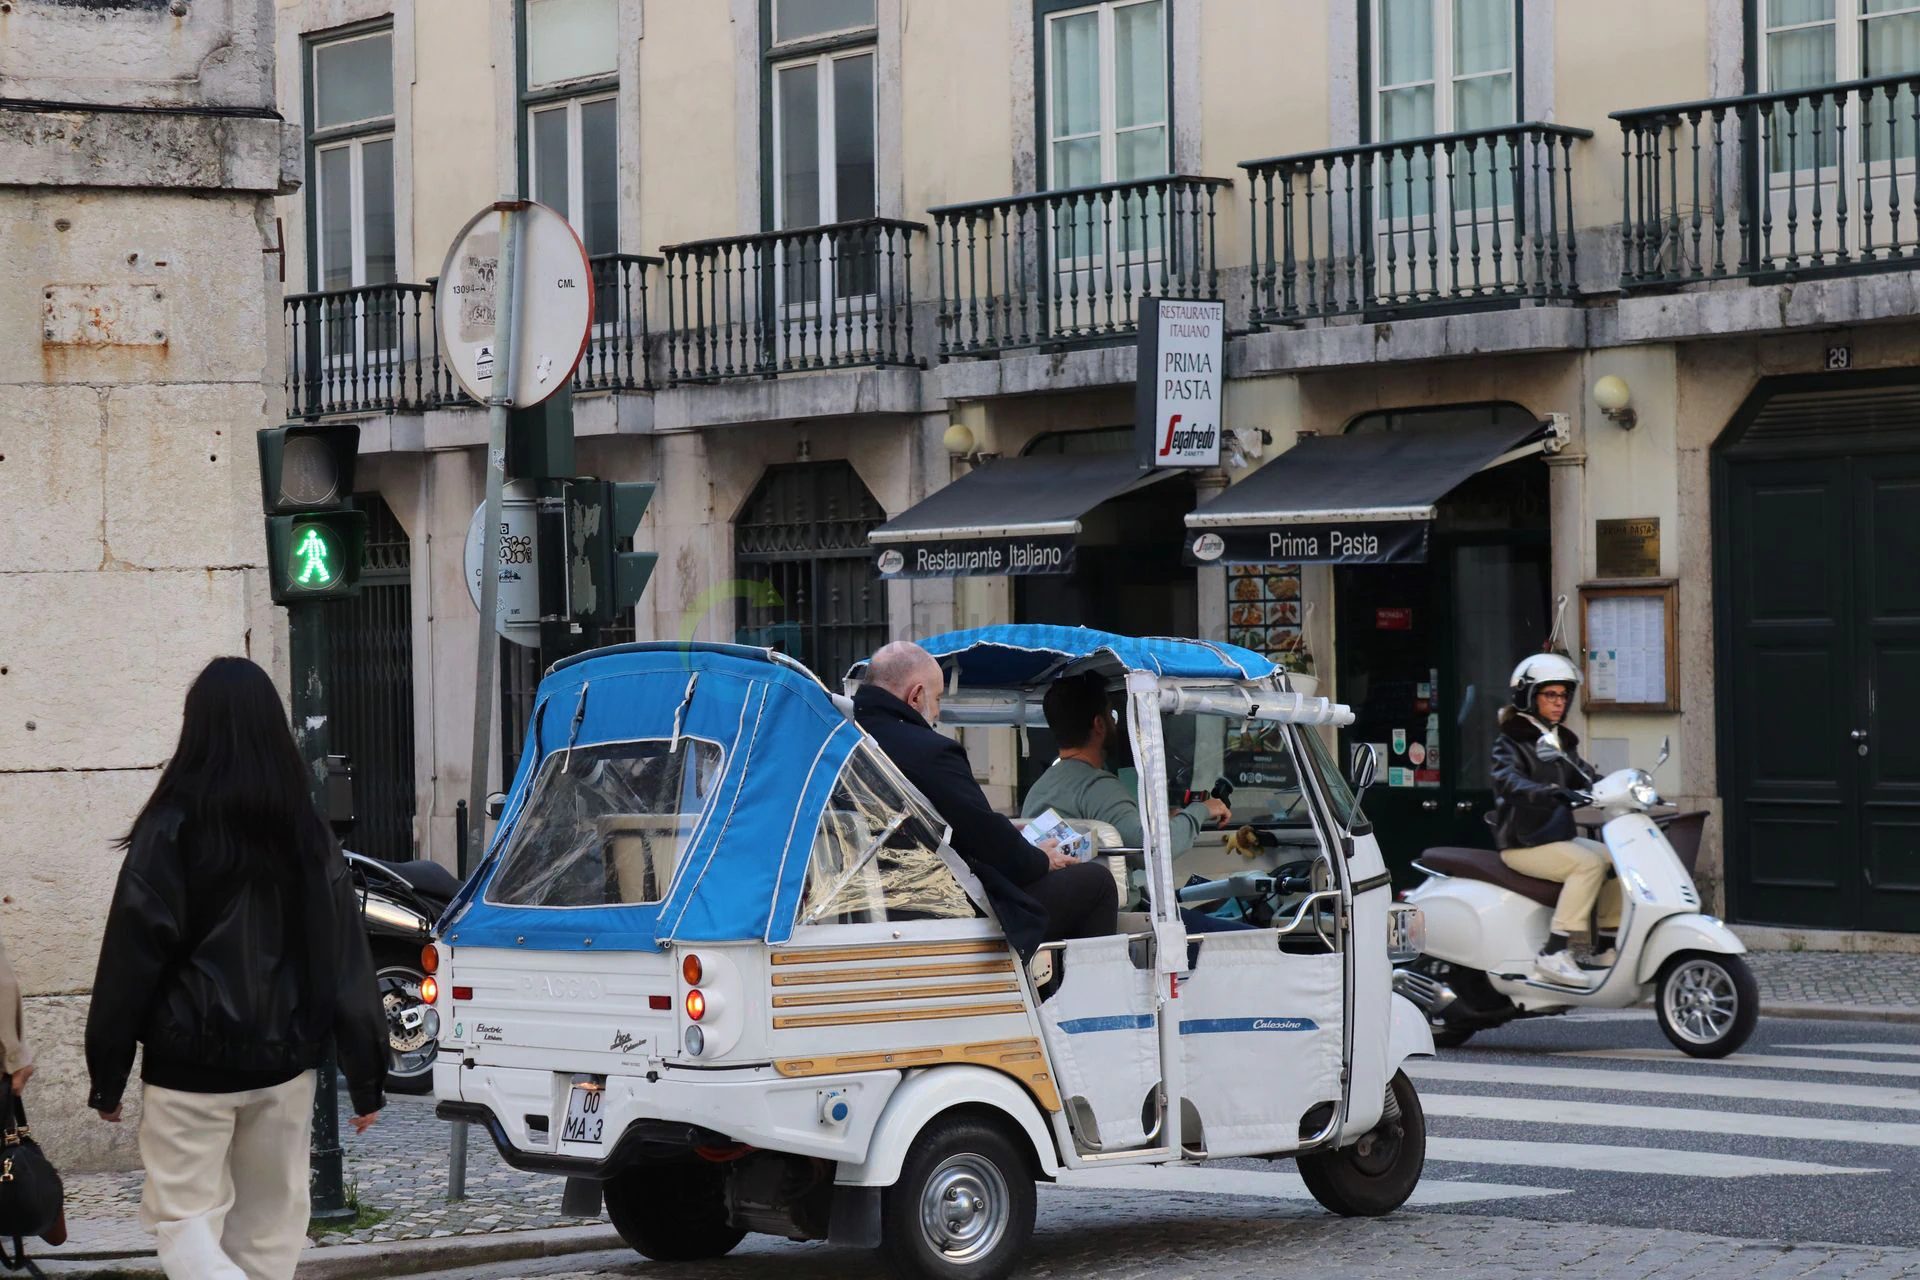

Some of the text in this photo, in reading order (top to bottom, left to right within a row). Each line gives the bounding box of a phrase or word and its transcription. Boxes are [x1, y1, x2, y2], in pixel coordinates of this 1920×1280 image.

[557, 279, 575, 288] CML
[1160, 305, 1221, 321] RESTAURANTE
[1170, 323, 1210, 339] ITALIANO
[1165, 352, 1212, 373] PRIMA
[1829, 347, 1847, 369] 29
[1165, 379, 1212, 400] PASTA
[1159, 414, 1215, 456] Segafredo
[1269, 531, 1379, 557] Prima Pasta
[916, 547, 1001, 571] Restaurante
[1009, 544, 1062, 567] Italiano
[476, 1023, 503, 1034] Electric
[1252, 1019, 1301, 1029] Calessino
[583, 1091, 601, 1114] 00
